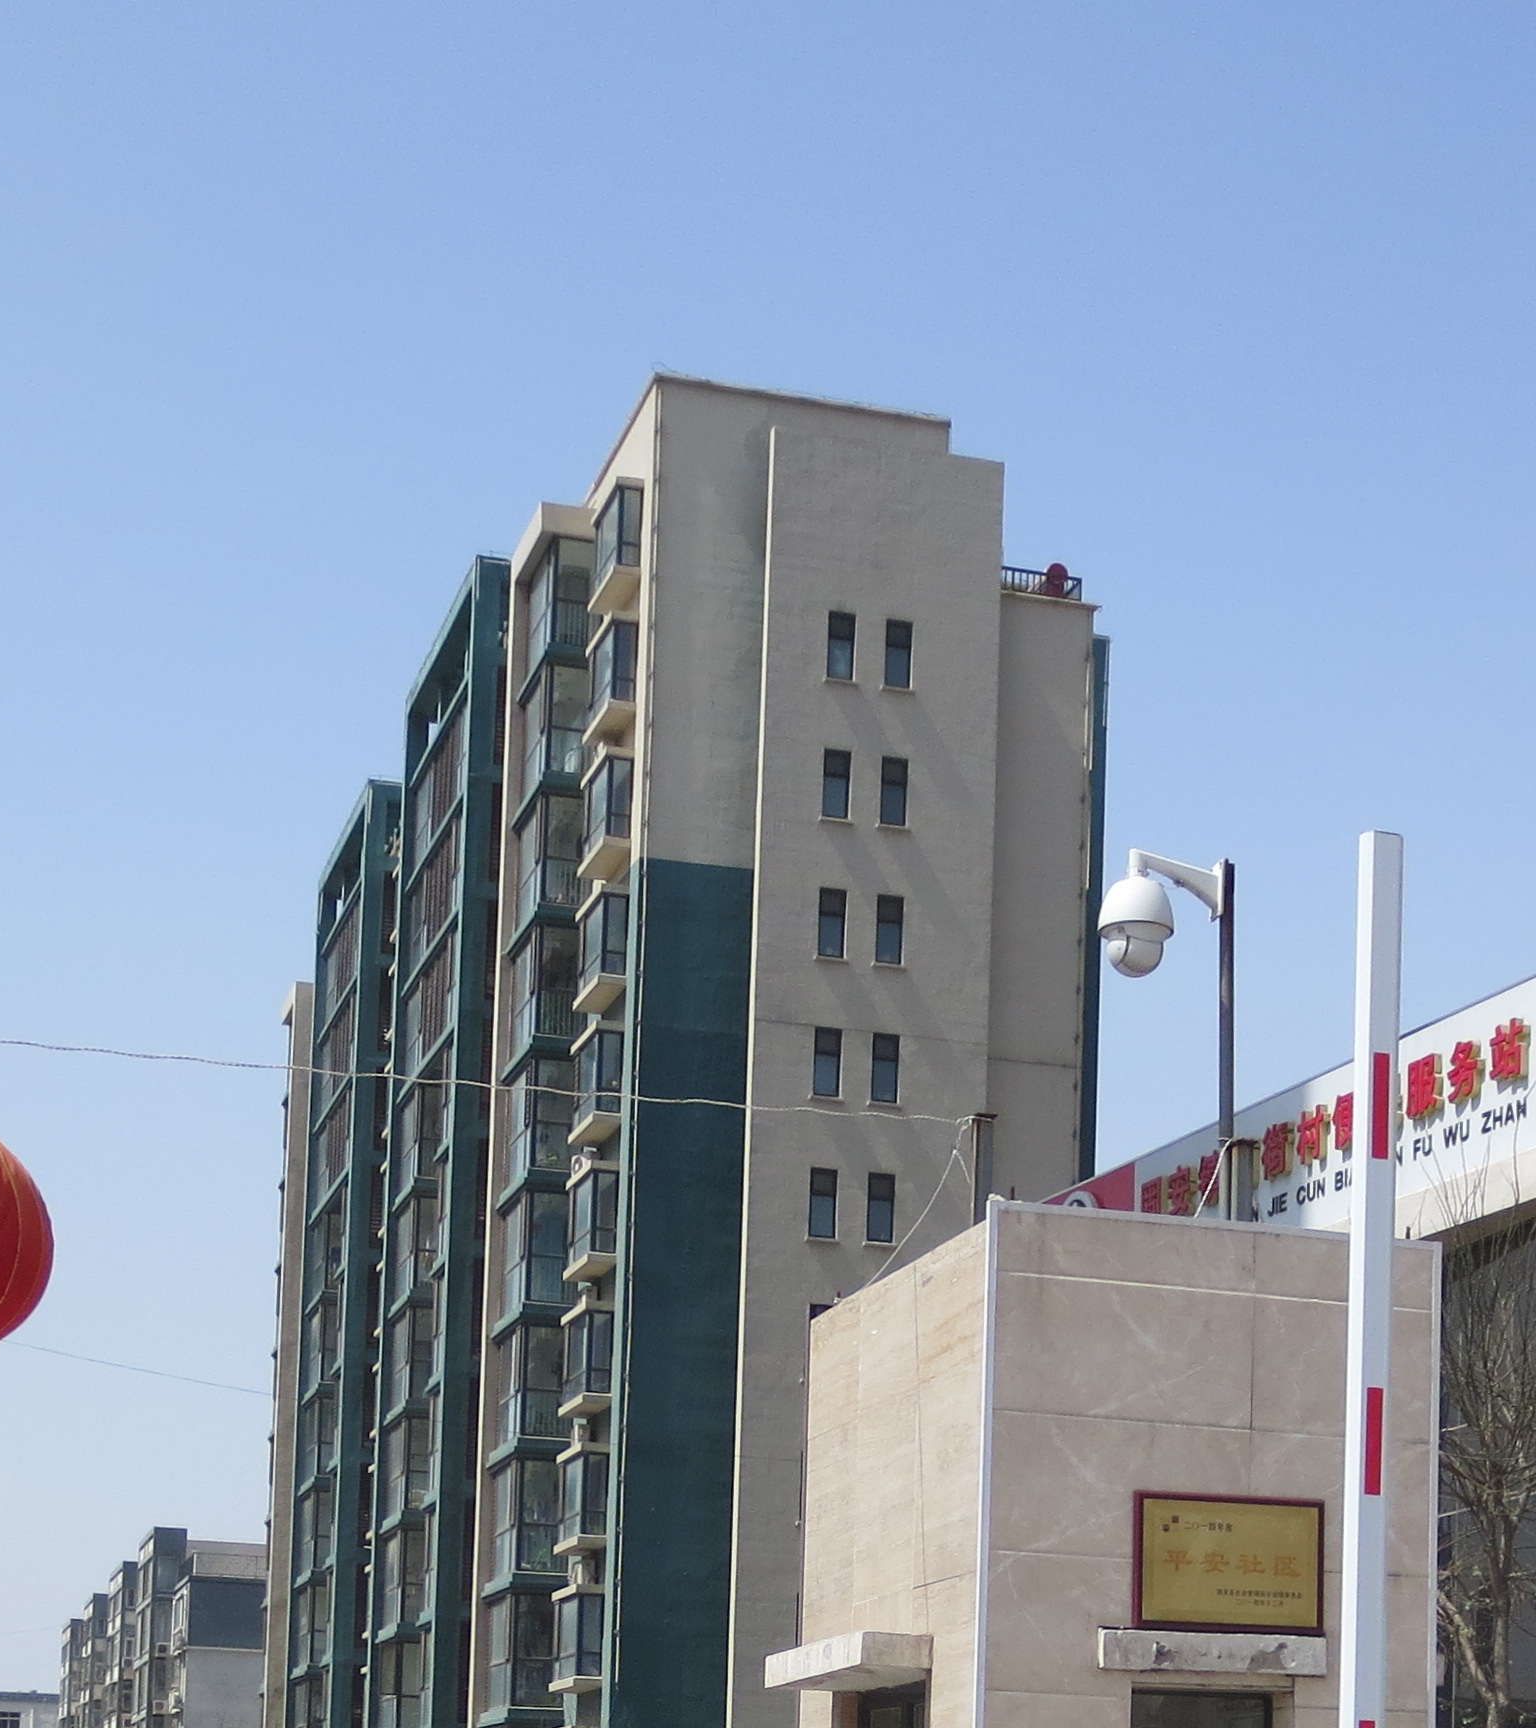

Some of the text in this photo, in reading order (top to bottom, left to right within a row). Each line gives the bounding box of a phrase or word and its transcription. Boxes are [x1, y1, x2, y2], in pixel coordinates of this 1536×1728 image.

[1267, 1192, 1289, 1218] JIE
[1296, 1176, 1326, 1206] CUN
[1413, 1134, 1433, 1162] FU
[1443, 1121, 1470, 1149] WU
[1481, 1096, 1527, 1135] ZHAN
[1163, 1548, 1301, 1579] 平安社区
